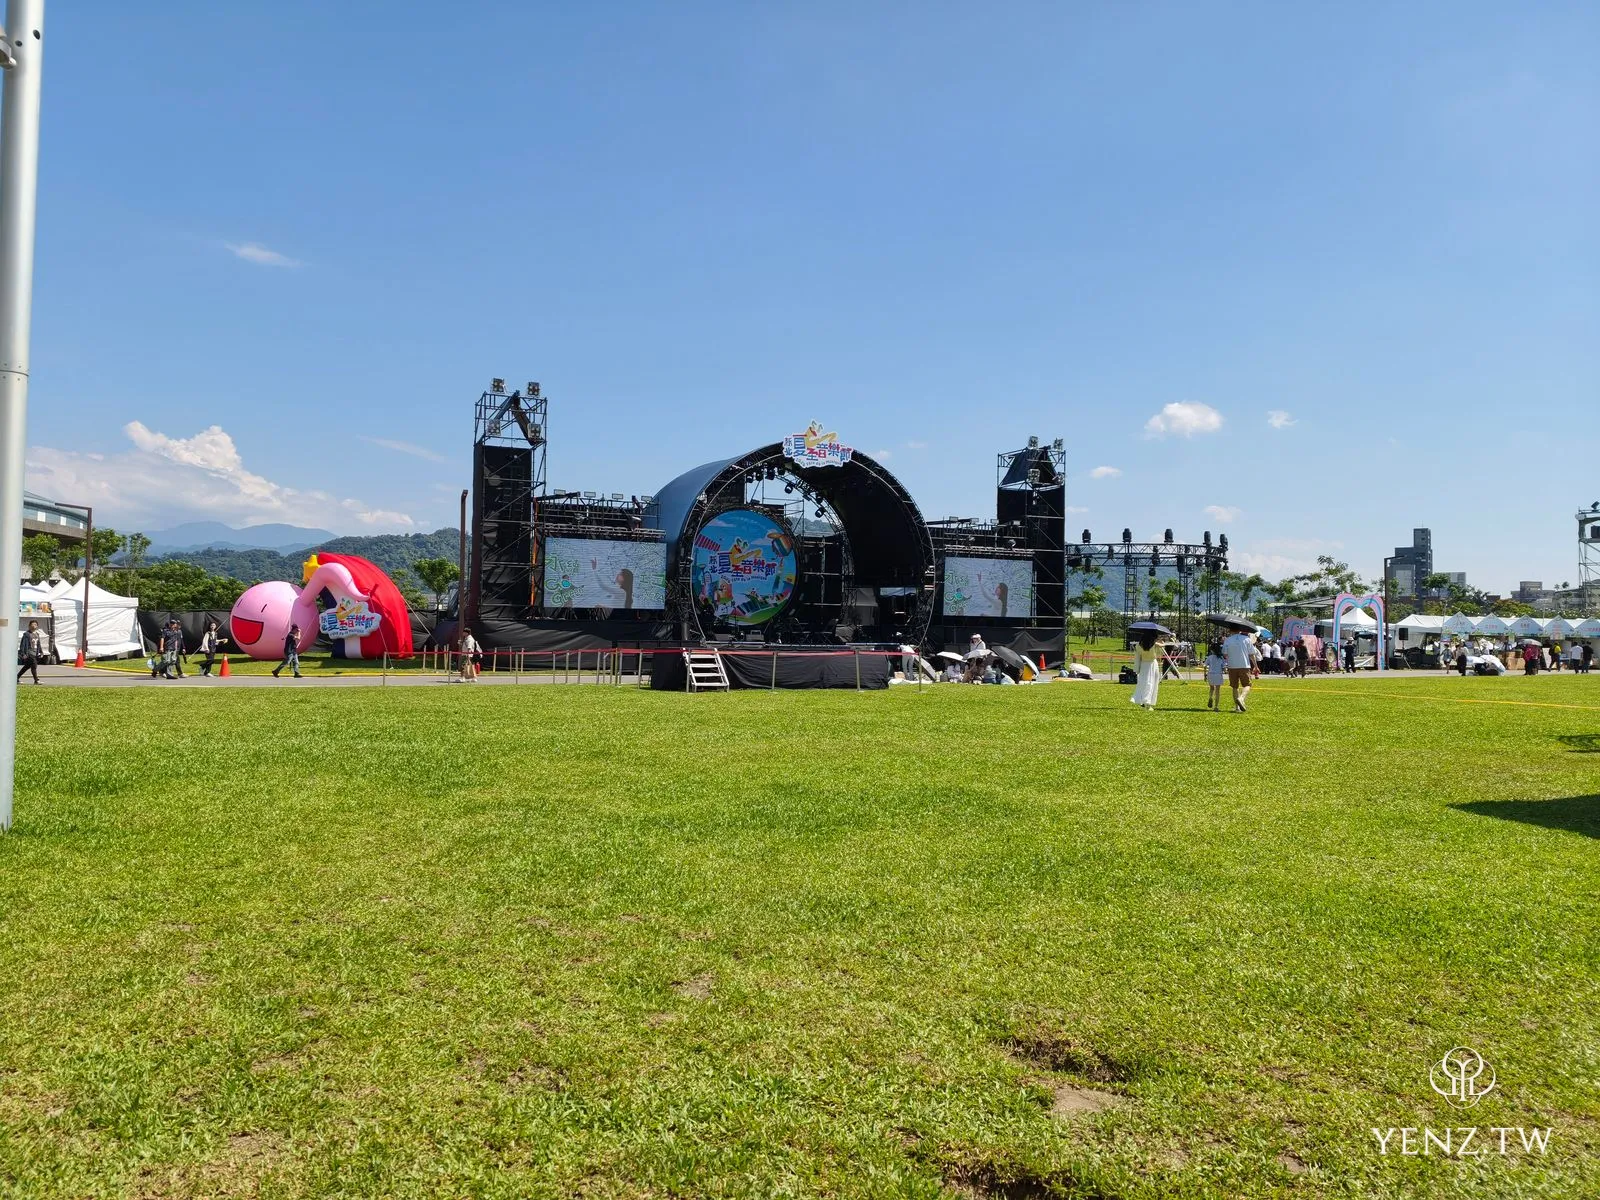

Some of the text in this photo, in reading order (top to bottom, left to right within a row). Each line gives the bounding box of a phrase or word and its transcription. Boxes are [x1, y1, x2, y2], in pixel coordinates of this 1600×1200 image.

[792, 434, 852, 461] 夏至音樂節
[717, 552, 777, 578] 夏至音樂節
